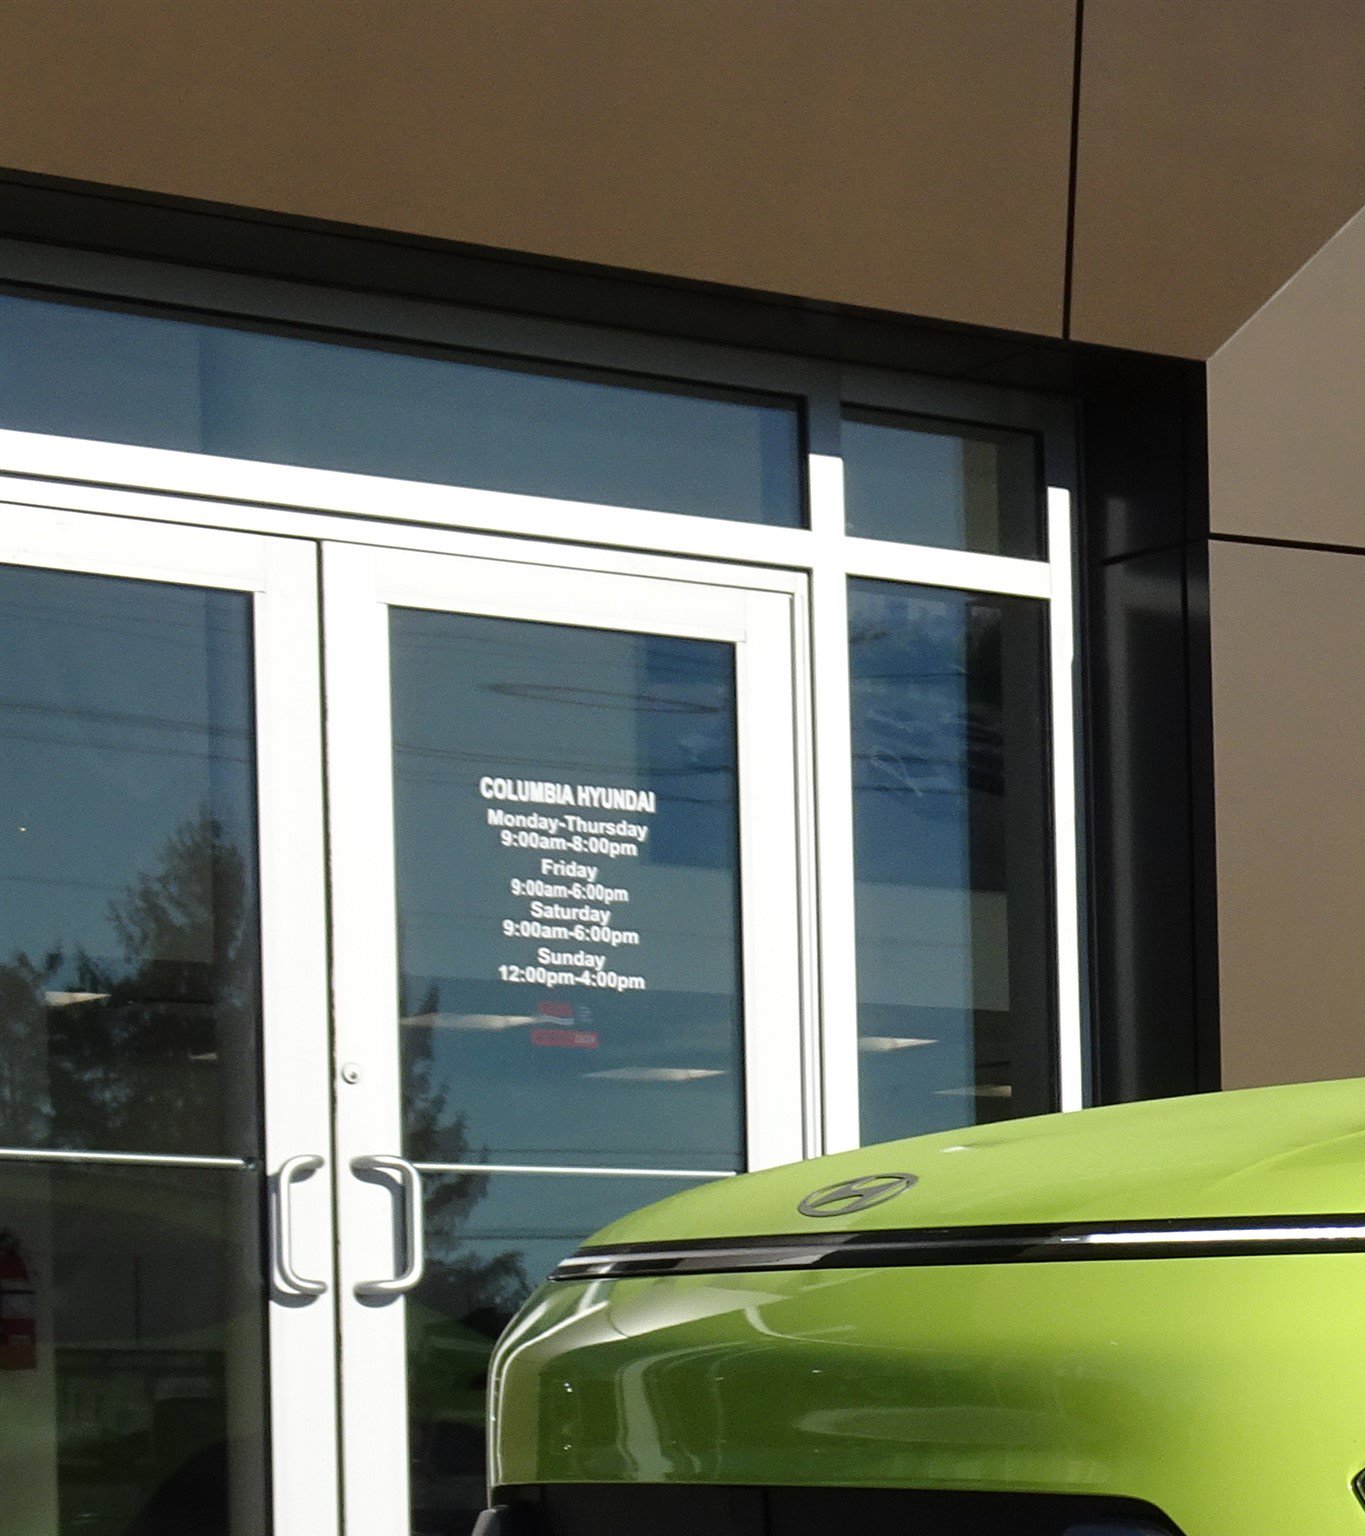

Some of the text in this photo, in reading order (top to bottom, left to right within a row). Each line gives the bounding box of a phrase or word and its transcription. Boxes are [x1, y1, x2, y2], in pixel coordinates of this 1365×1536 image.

[479, 776, 657, 813] COLUMBIA HYUNDAI
[486, 808, 649, 842] Monday-Thursday
[500, 830, 639, 858] 9:00am-8:00pm
[540, 858, 599, 882] Friday
[510, 877, 630, 905] 9:00am-6:00pm
[529, 900, 611, 926] Saturday
[502, 918, 640, 947] 9:00am-6:00pm
[536, 946, 606, 971] Sunday
[498, 964, 646, 992] 12:00pm-4:00pm
